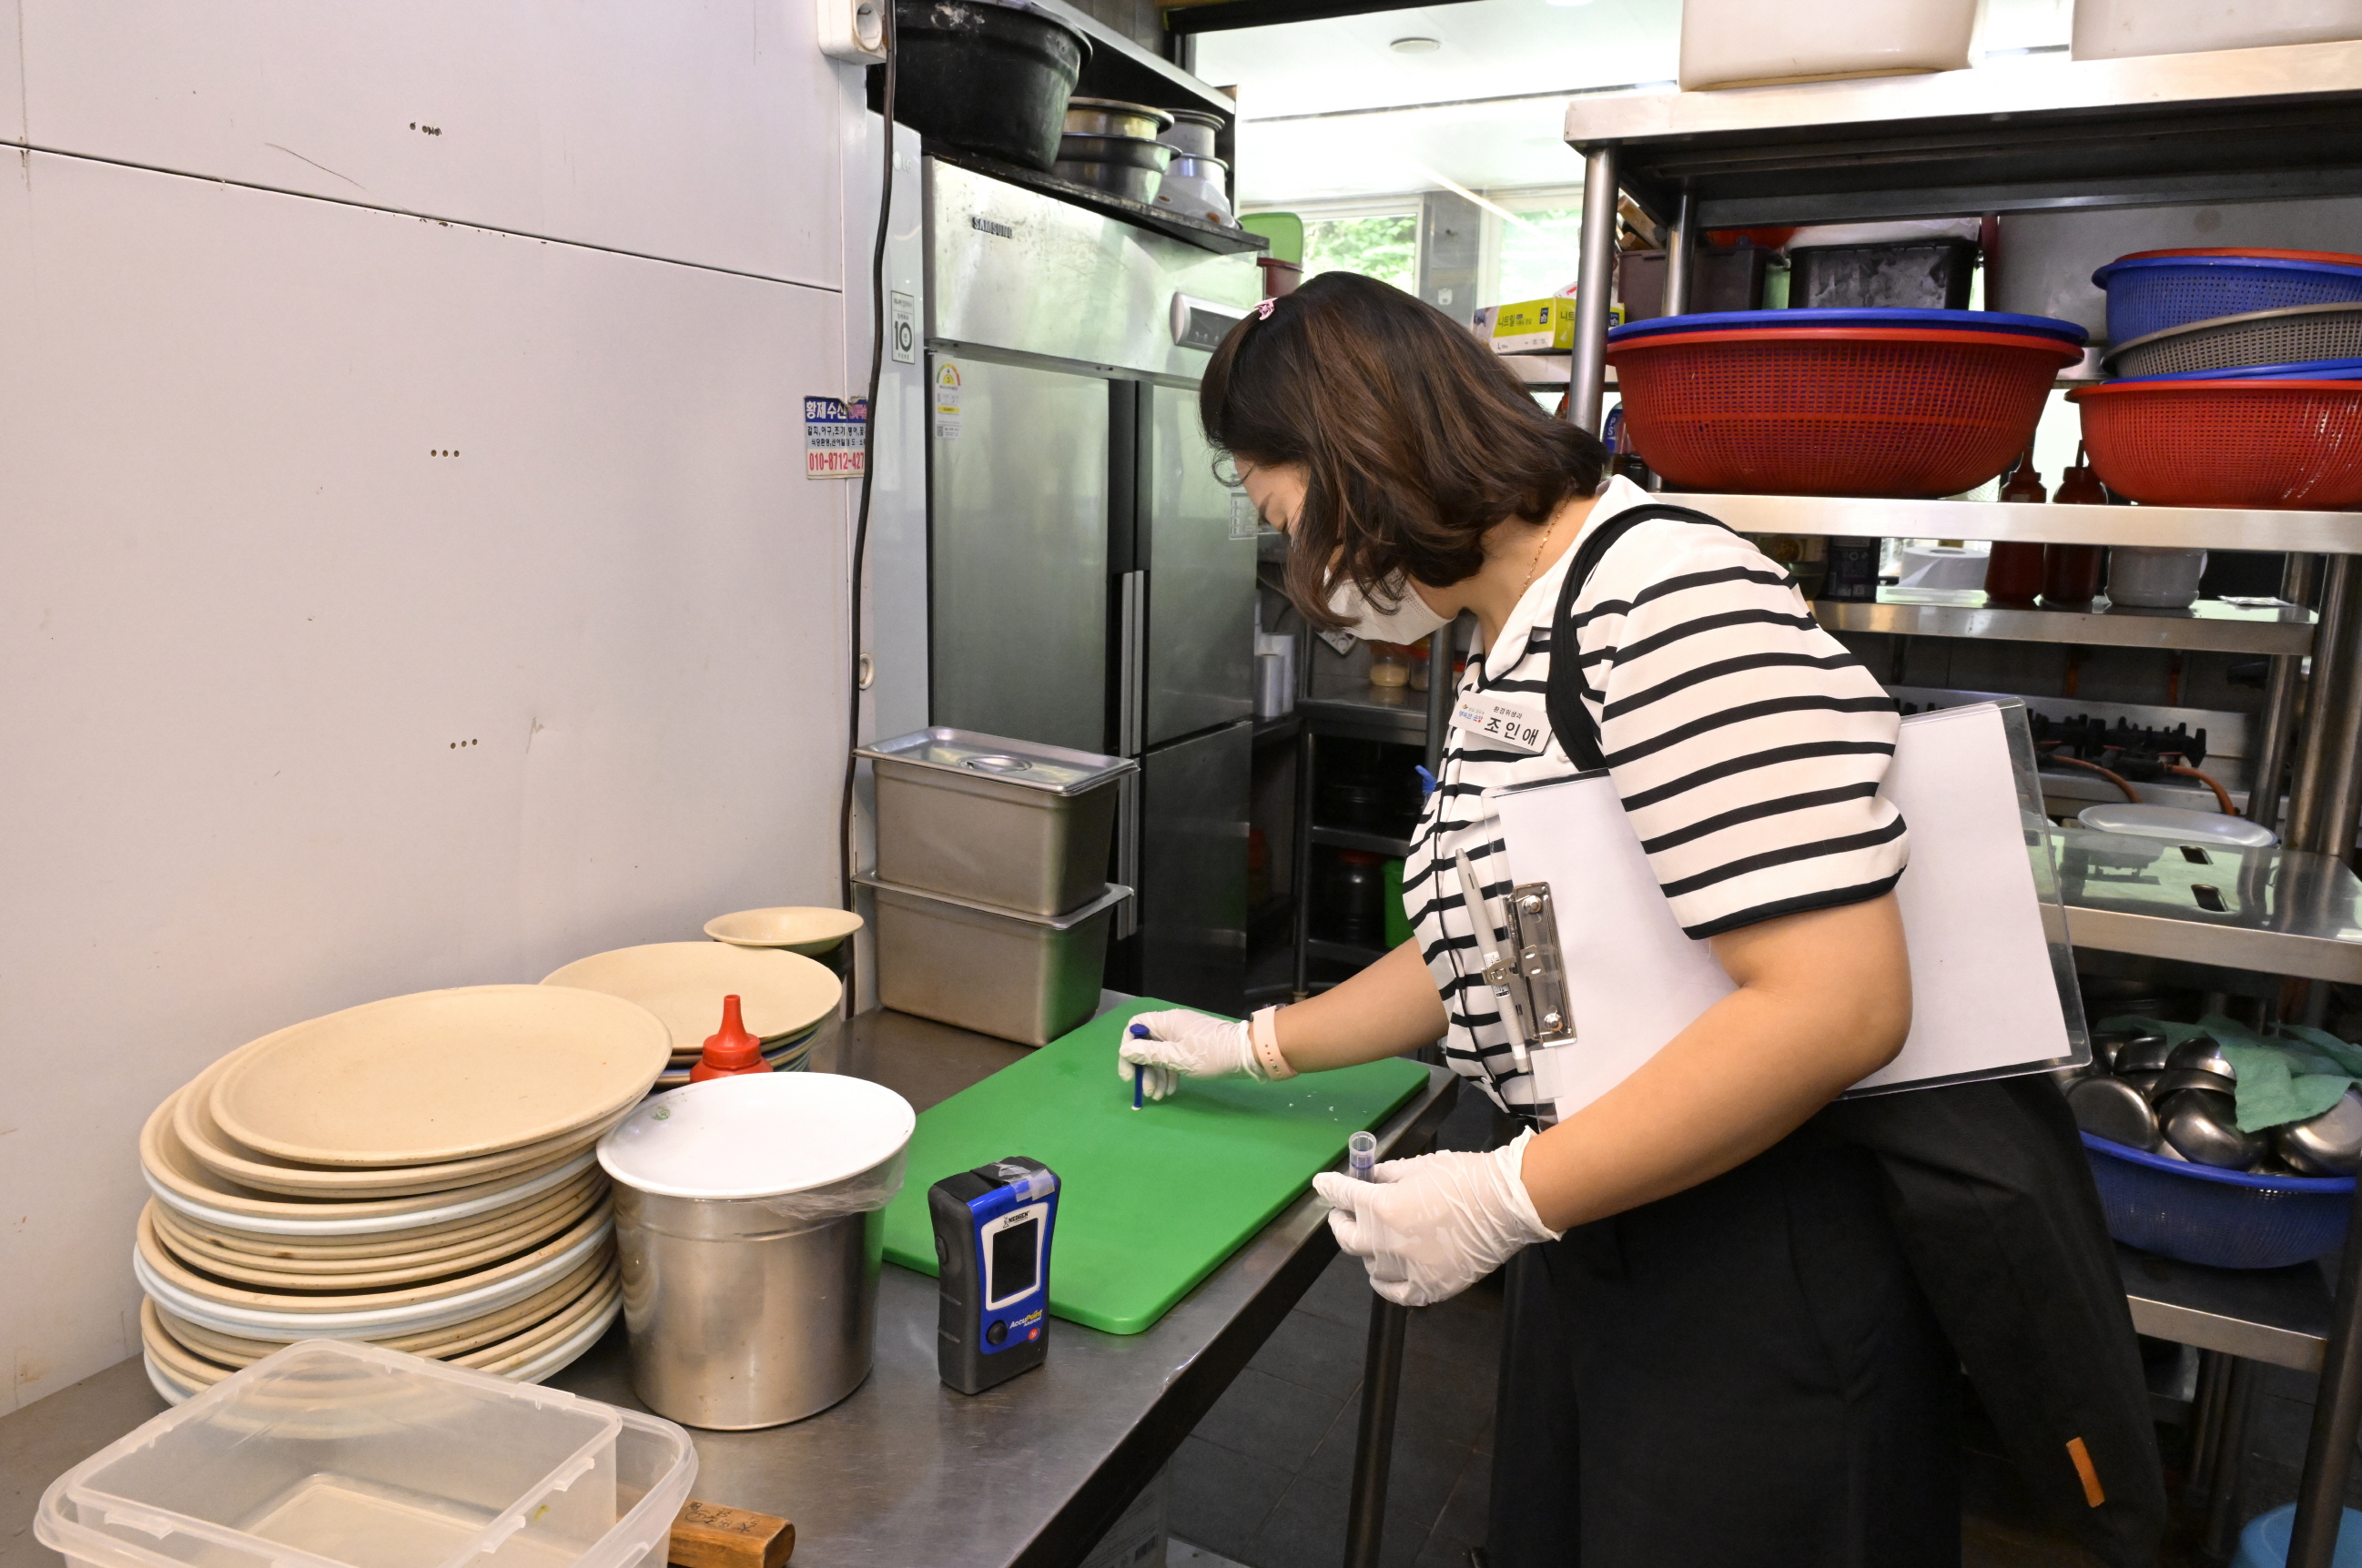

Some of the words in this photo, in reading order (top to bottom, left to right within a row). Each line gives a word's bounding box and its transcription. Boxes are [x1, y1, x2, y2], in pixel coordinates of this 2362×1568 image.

[971, 217, 1013, 239] SAMSUNG
[894, 320, 913, 353] 10
[806, 400, 847, 420] 황제수산
[809, 452, 865, 471] 010-8712-427
[1494, 706, 1523, 719] 환경위생과
[1485, 717, 1539, 746] 조인애
